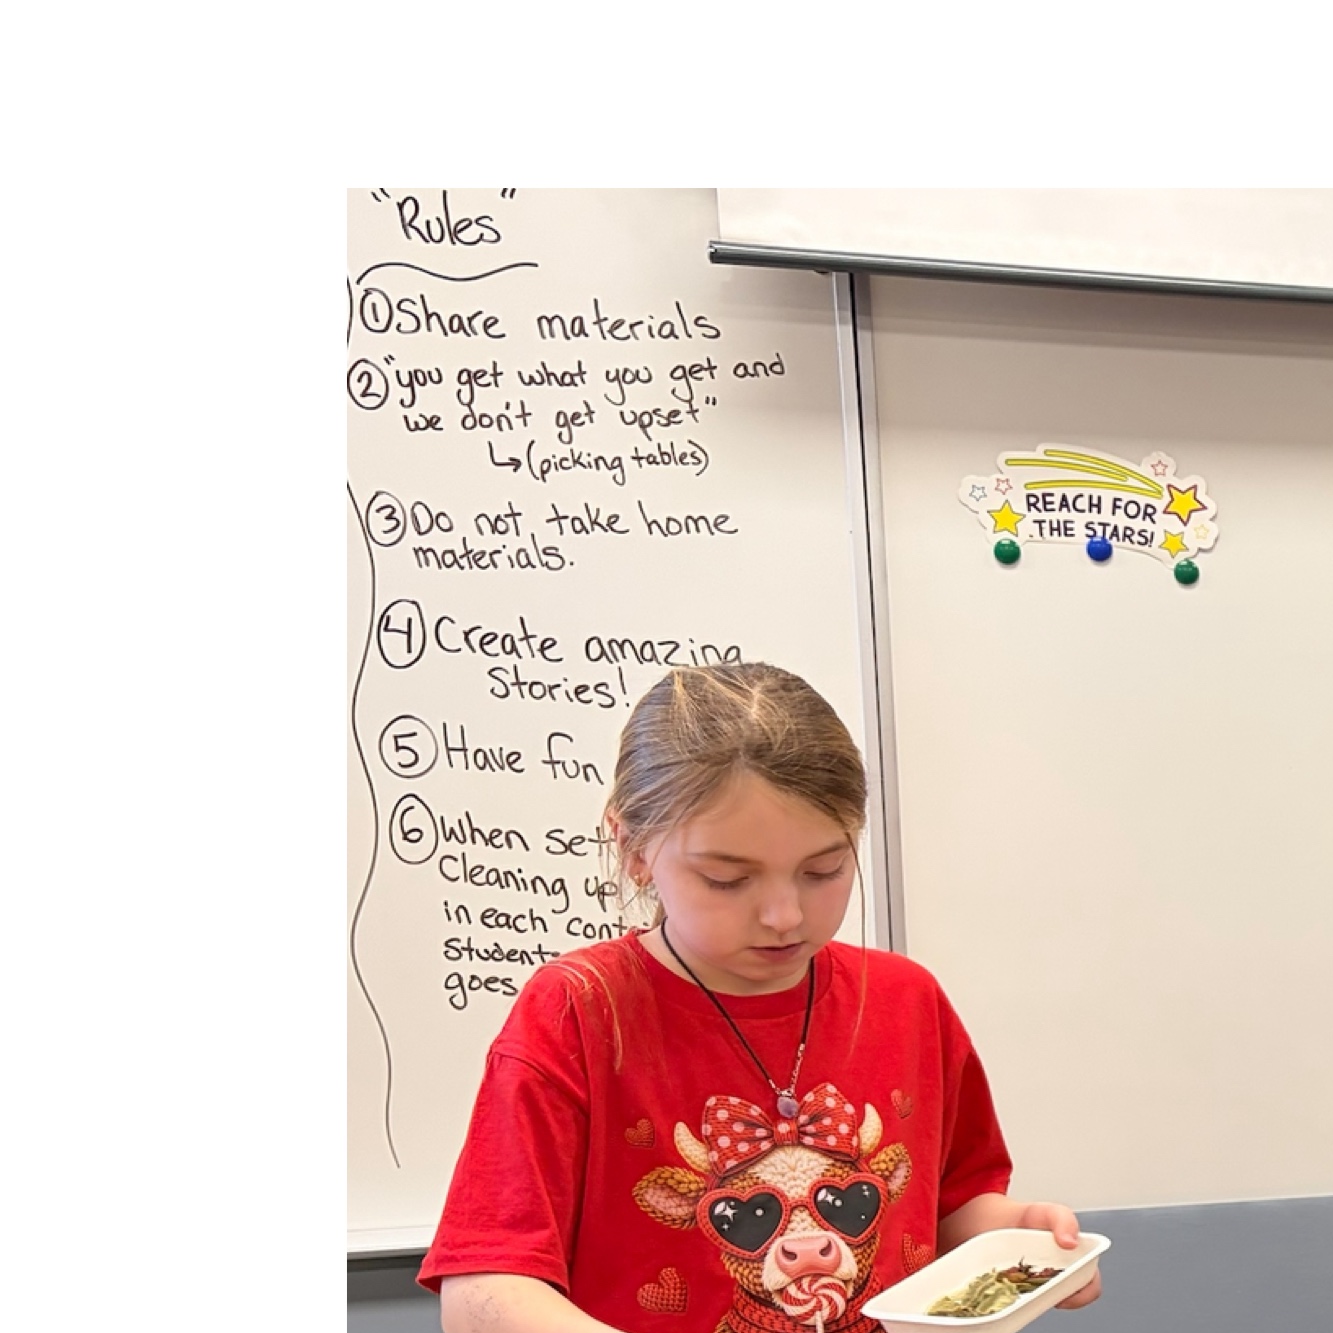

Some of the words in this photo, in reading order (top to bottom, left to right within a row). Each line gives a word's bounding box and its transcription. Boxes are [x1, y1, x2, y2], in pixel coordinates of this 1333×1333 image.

[396, 295, 505, 340] Share
[537, 299, 721, 342] materials
[457, 361, 503, 407] get
[518, 361, 587, 388] what
[605, 367, 653, 405] you
[670, 356, 718, 401] get
[733, 353, 785, 378] and
[404, 413, 444, 433] we
[461, 401, 532, 433] don't
[556, 408, 596, 444] get
[411, 501, 454, 535] Do
[474, 503, 523, 536] not
[546, 503, 629, 535] take
[638, 501, 739, 536] home
[1026, 493, 1102, 514] REACH
[1112, 498, 1157, 524] FOR
[1033, 520, 1075, 538] THE
[1085, 521, 1155, 548] STARS!
[434, 615, 564, 664] Create
[443, 723, 525, 774] Have
[541, 732, 604, 786] fun
[438, 811, 529, 852] When
[438, 854, 570, 914] Cleaning
[444, 901, 472, 926] in
[480, 907, 549, 935] each
[444, 971, 518, 1010] goes
